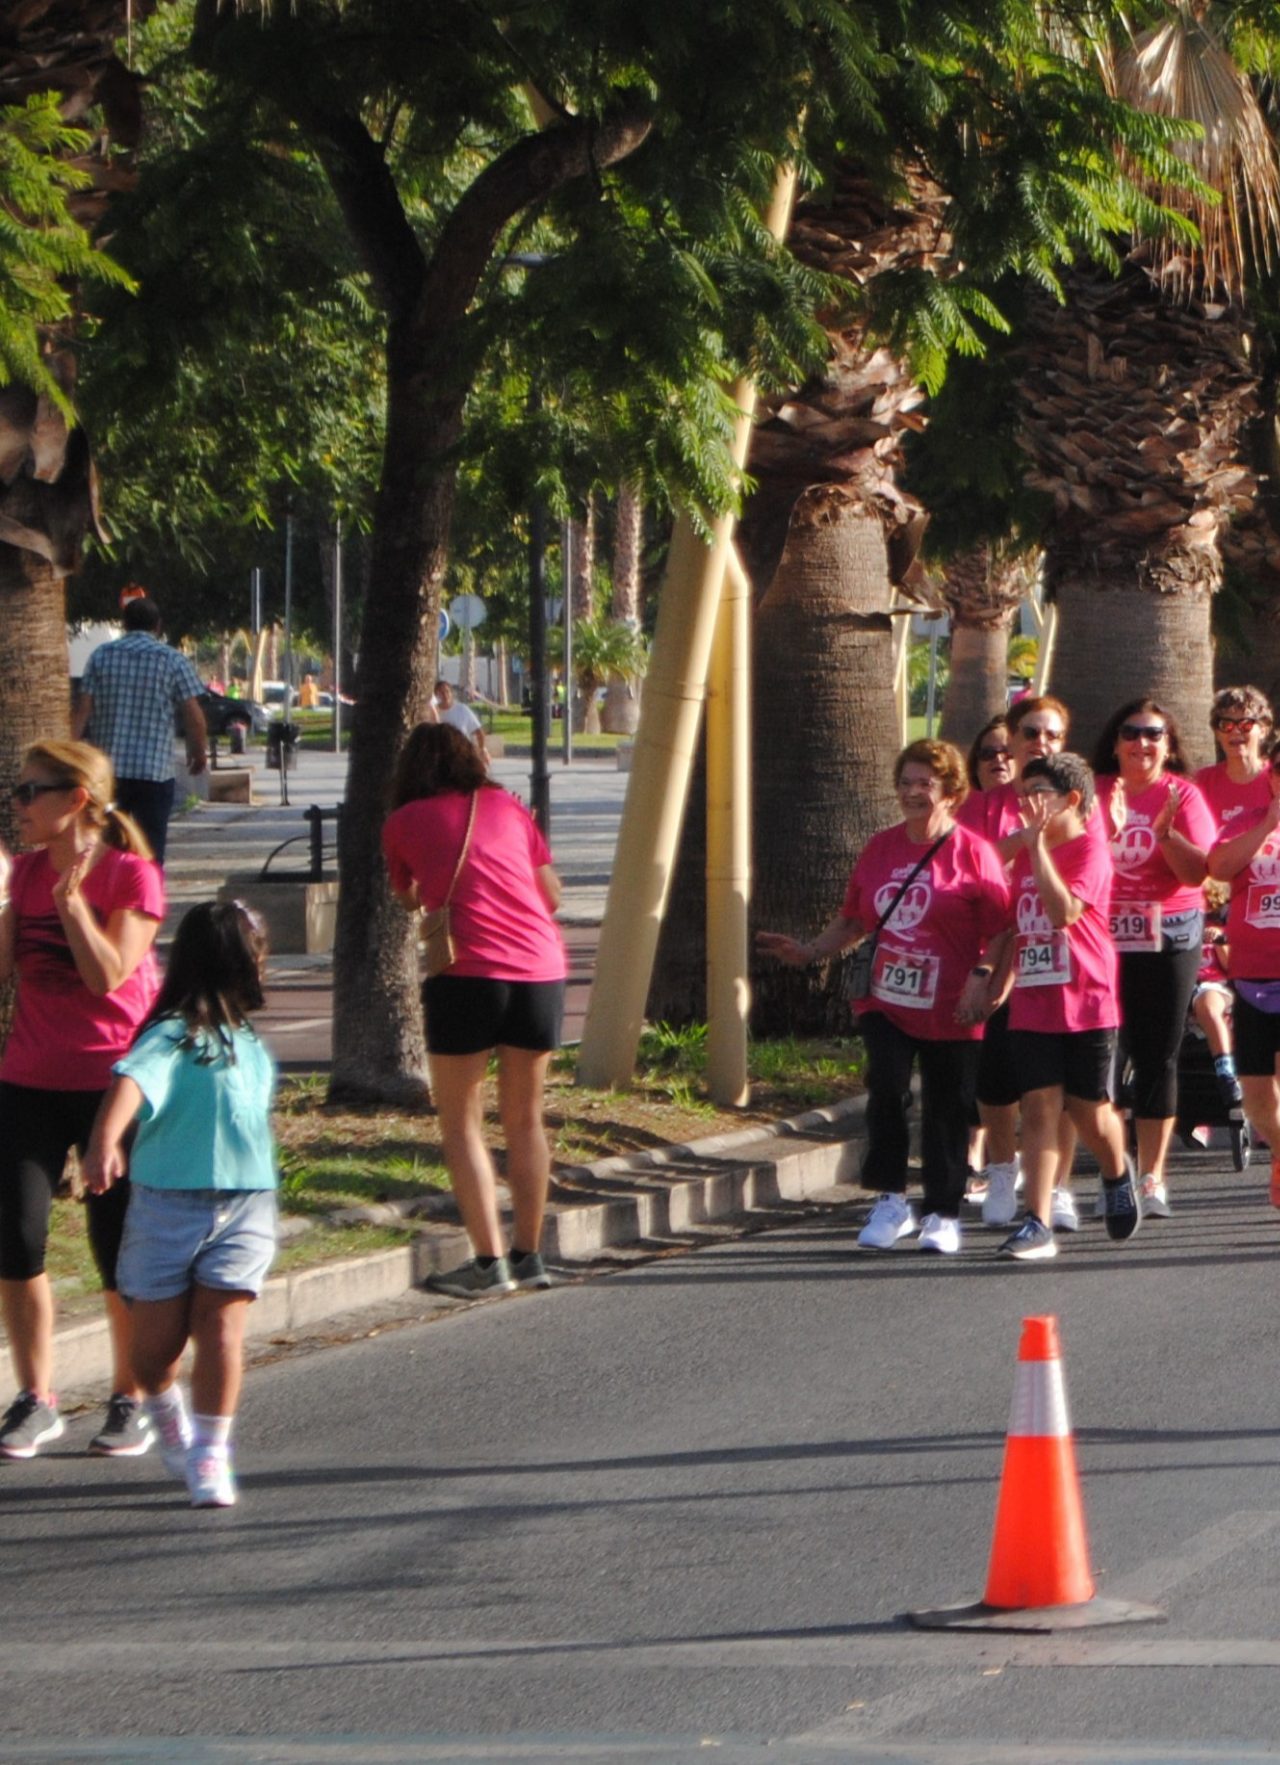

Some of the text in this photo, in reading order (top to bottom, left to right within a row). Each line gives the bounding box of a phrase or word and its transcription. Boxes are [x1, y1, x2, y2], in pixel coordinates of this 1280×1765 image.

[1109, 916, 1144, 934] 519
[1020, 946, 1051, 967] 794
[885, 965, 918, 988] 791
